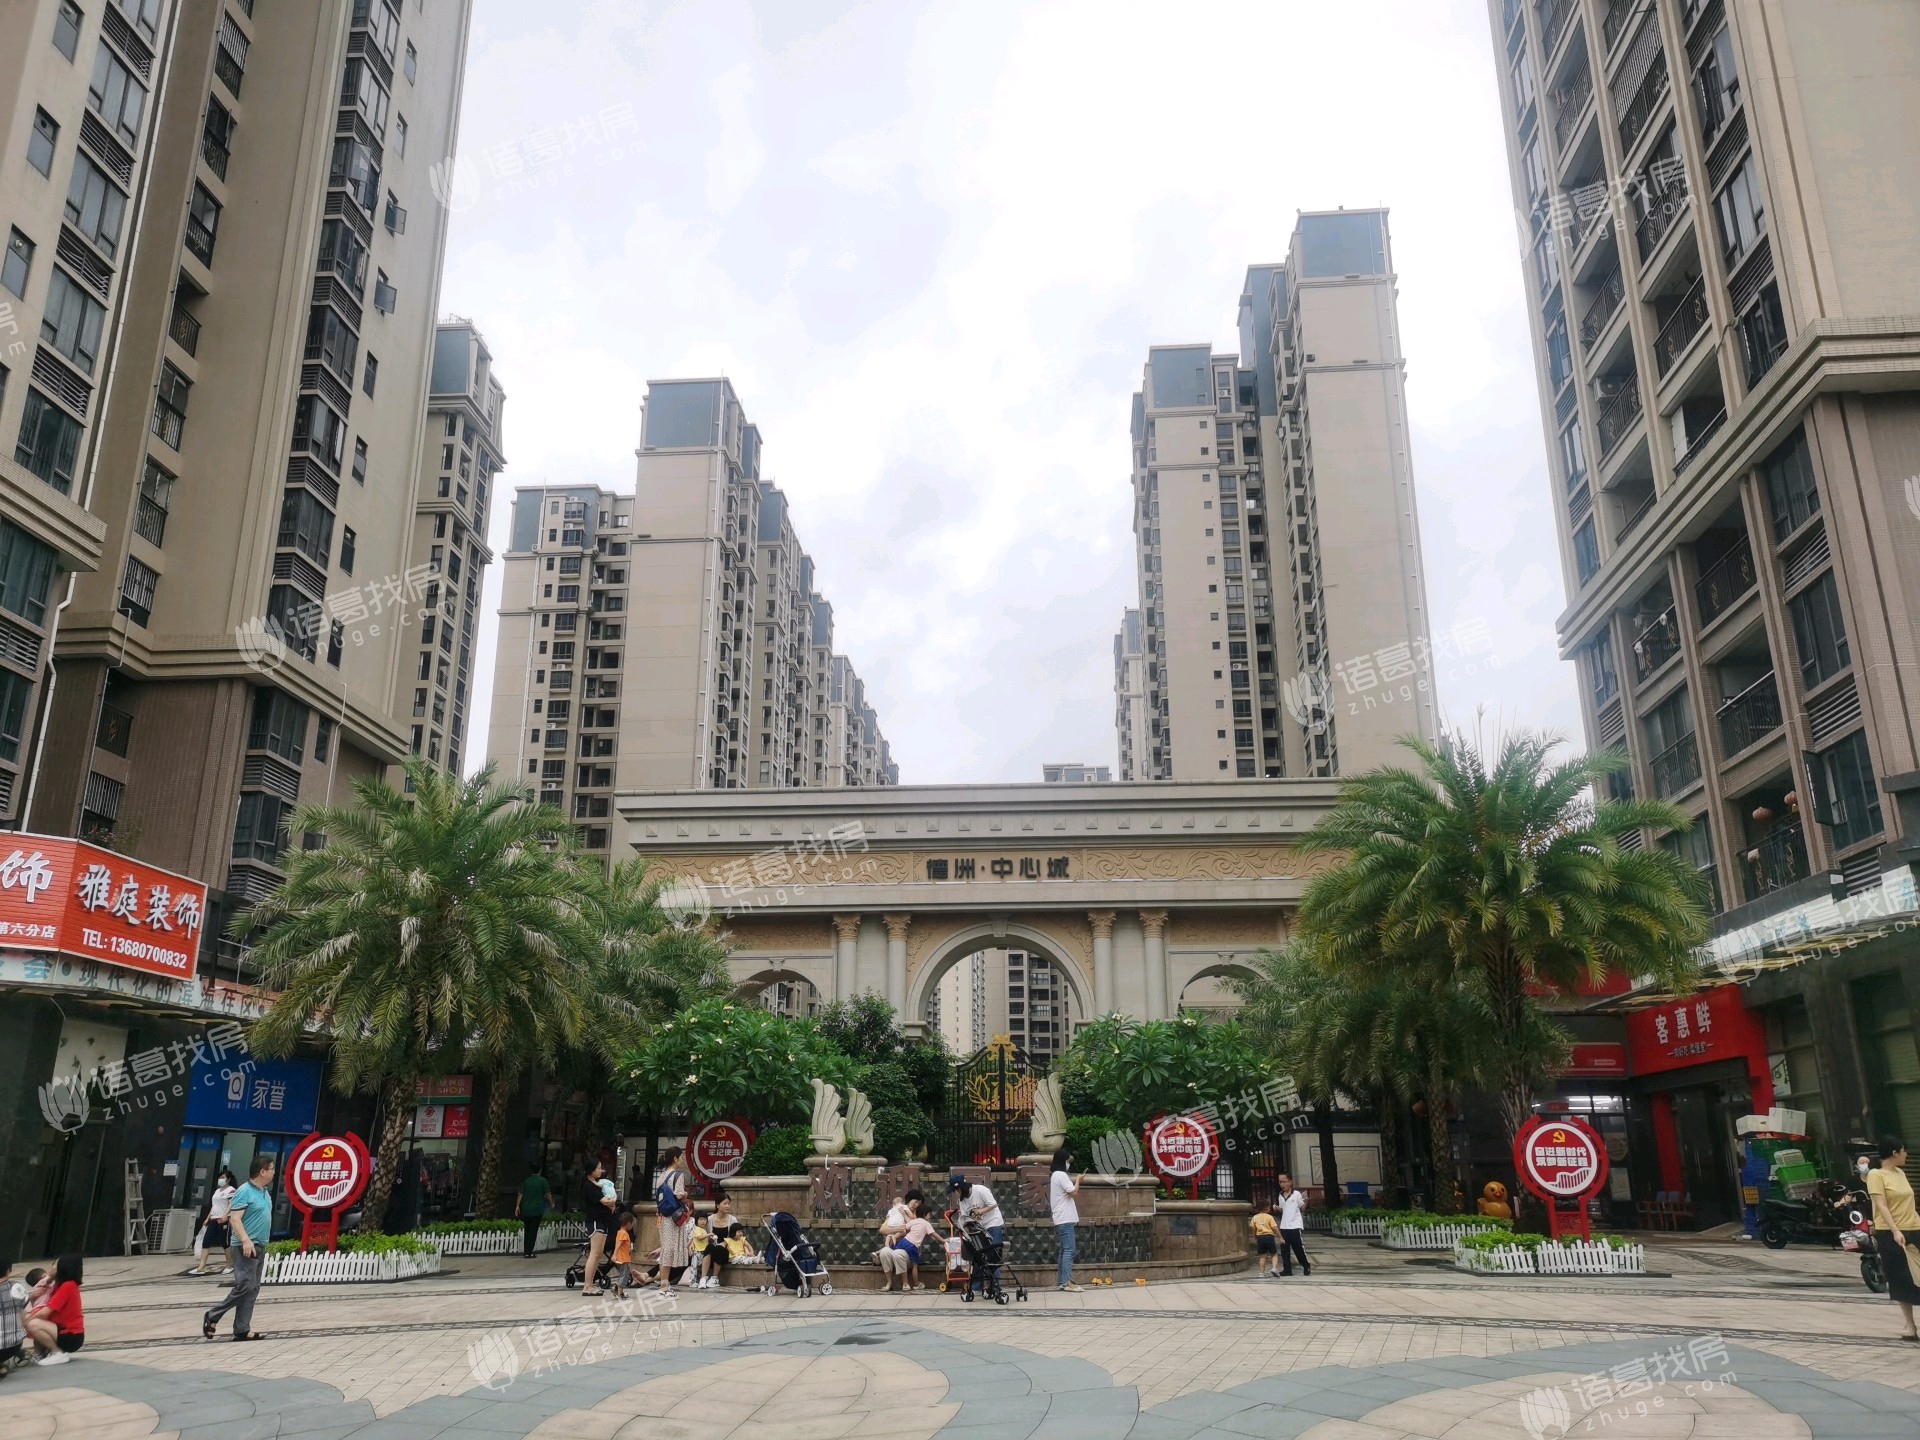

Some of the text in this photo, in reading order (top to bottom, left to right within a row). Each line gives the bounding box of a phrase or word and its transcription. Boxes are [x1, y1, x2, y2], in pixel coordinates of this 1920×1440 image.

[0, 850, 53, 902] 饰
[78, 864, 200, 939] 雅庭装饰
[82, 928, 188, 969] TEL: 13680700832
[251, 1078, 286, 1110] 家誉
[701, 1140, 733, 1148] 不忘初心
[708, 1148, 740, 1156] 牢记使命
